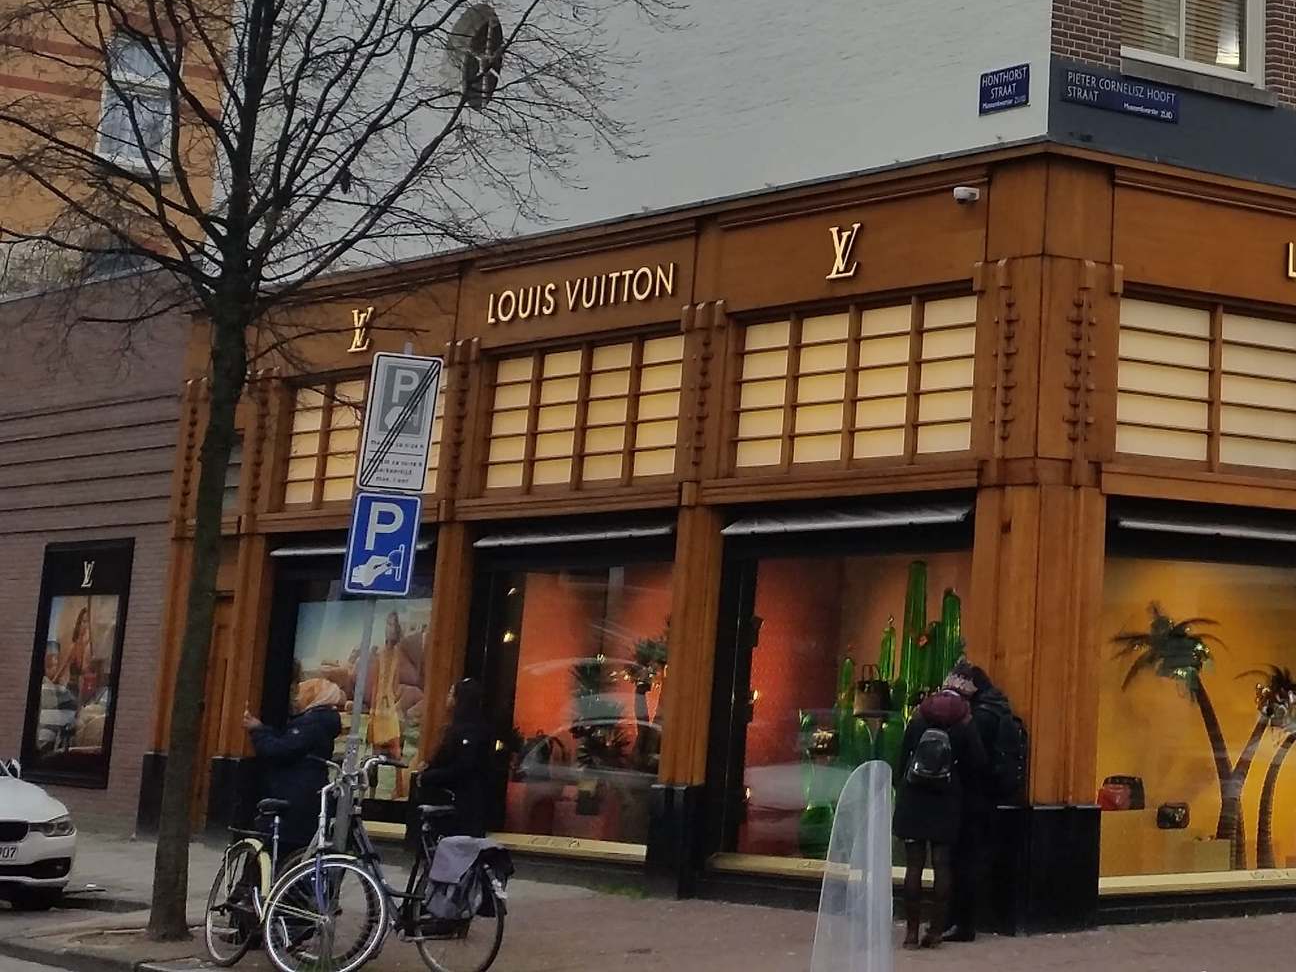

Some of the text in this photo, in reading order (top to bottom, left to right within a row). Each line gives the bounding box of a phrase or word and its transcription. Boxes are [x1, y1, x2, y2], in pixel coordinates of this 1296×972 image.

[982, 67, 1027, 88] HONTHORST
[991, 83, 1016, 99] STRAAT
[1067, 71, 1177, 105] PIETER CORNELISZ HOOFT
[1067, 86, 1099, 102] STRAAT
[486, 262, 677, 325] LOUIS VUITTON
[365, 501, 405, 550] P
